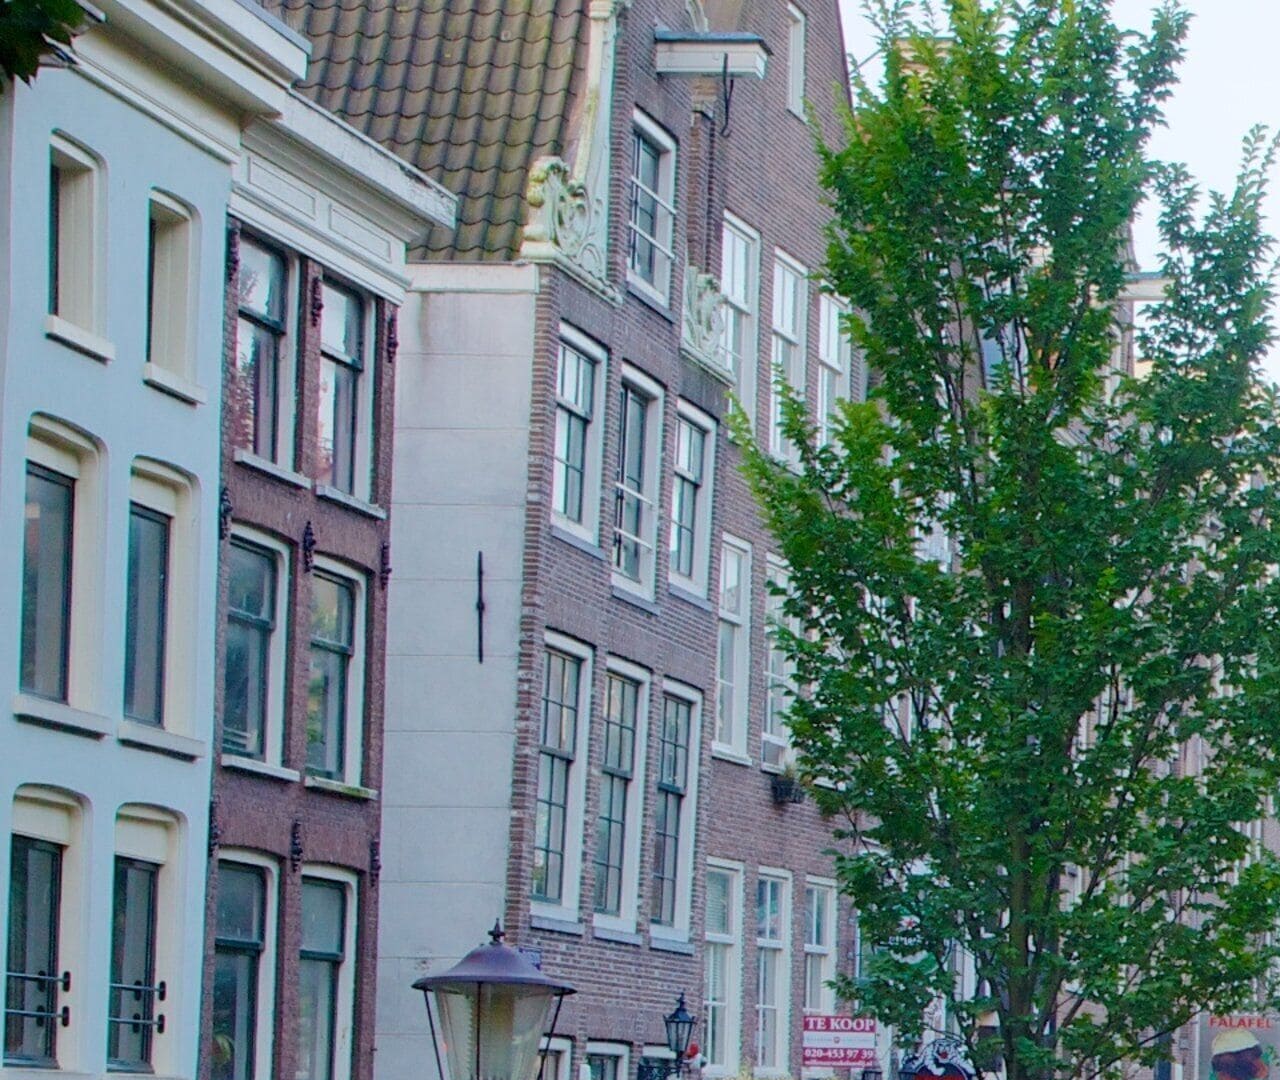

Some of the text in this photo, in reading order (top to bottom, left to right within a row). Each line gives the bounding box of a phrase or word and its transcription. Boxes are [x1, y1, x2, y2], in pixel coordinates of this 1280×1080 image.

[806, 1017, 874, 1031] TE KOOP
[1208, 1017, 1273, 1029] FALAFEL
